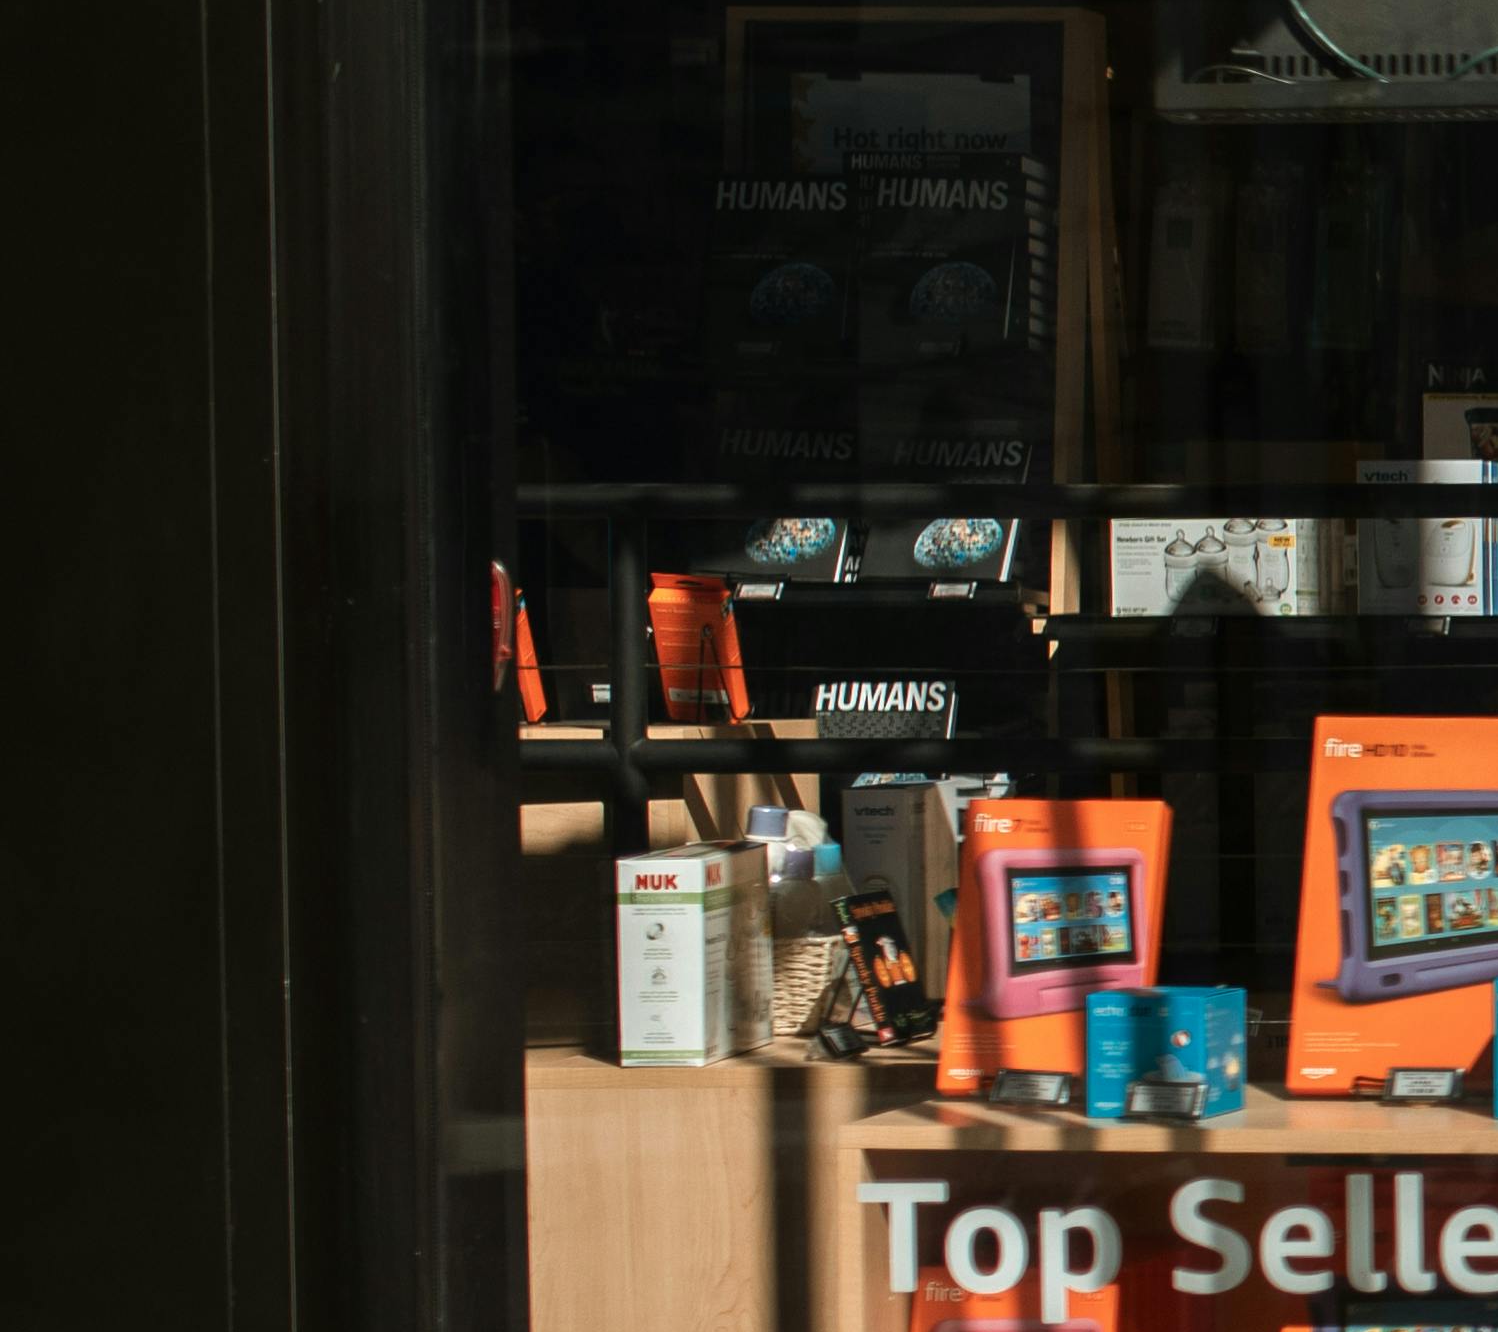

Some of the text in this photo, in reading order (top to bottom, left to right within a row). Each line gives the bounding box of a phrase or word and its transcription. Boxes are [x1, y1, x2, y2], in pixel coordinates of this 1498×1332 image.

[832, 126, 1007, 154] Hot right now
[850, 153, 923, 170] HUMANS
[715, 180, 848, 211] HUMANS
[876, 177, 1009, 210] HUMANS
[1428, 363, 1487, 389] NINJA
[718, 427, 855, 462] HUMANS
[892, 437, 1023, 468] HUMANS
[815, 681, 948, 713] HUMANS
[854, 806, 895, 817] vtech
[635, 874, 678, 890] NUK
[857, 1177, 1123, 1324] Top
